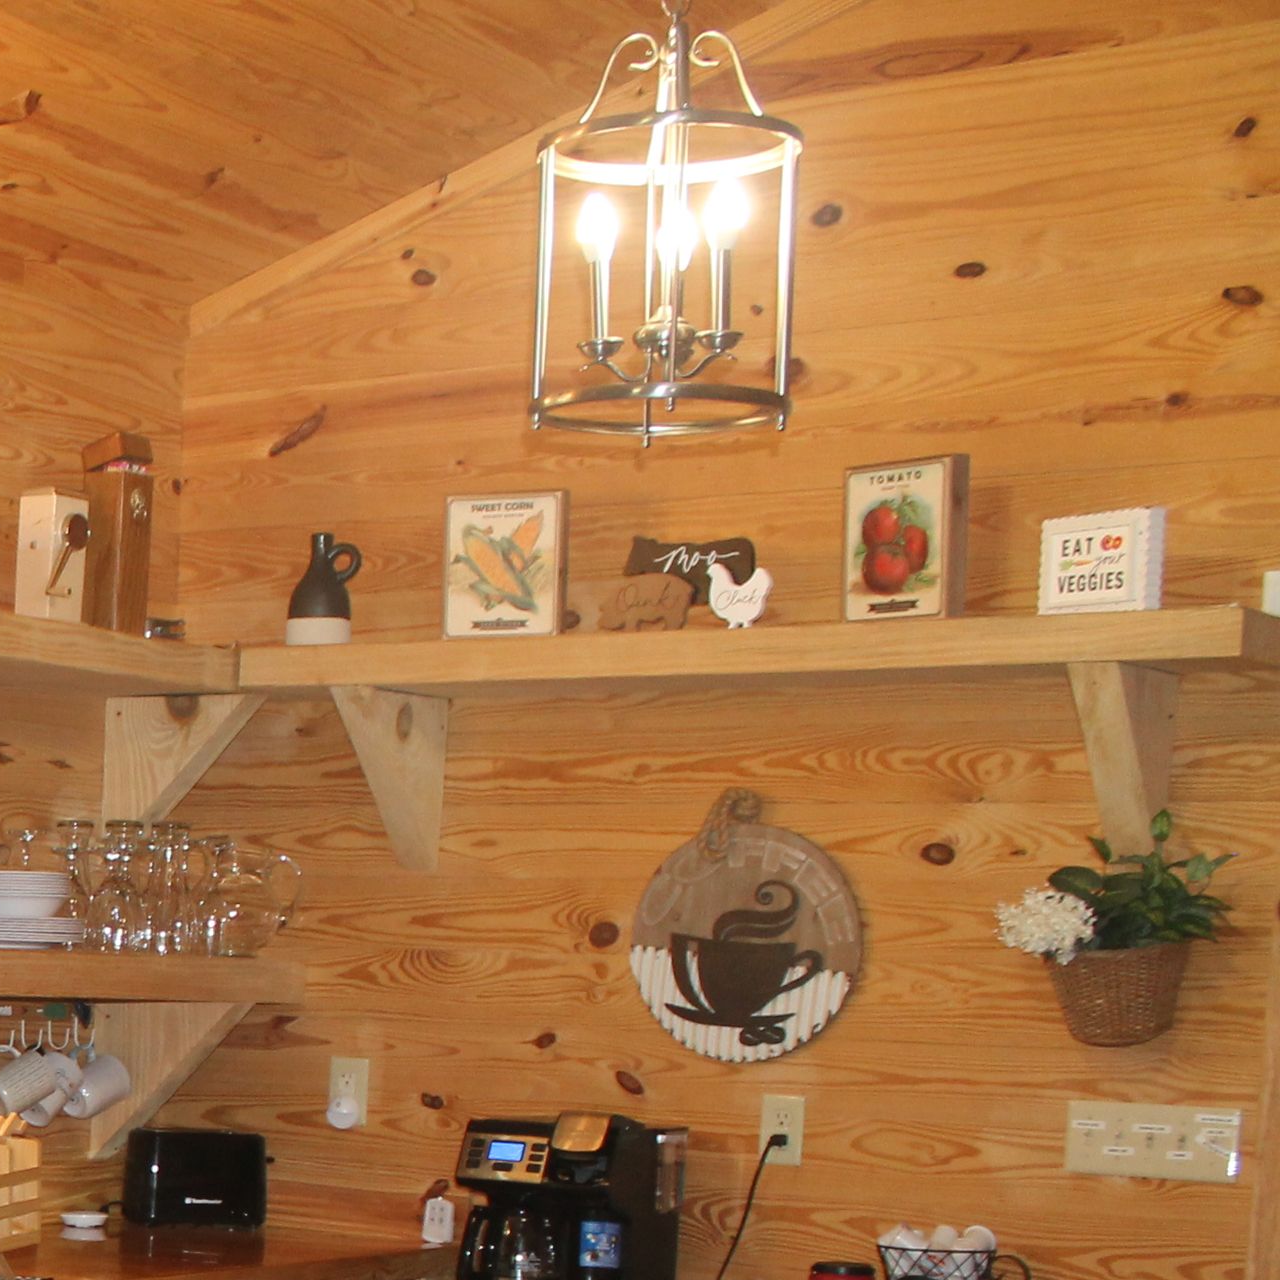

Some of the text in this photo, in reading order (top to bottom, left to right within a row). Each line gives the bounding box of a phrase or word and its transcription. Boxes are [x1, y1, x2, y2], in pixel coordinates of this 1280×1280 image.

[869, 469, 922, 486] TOMATO
[471, 501, 534, 512] SWEET CORN
[1061, 537, 1094, 558] EAT
[1058, 570, 1124, 594] VEGGIES
[643, 837, 855, 946] COFFEE
